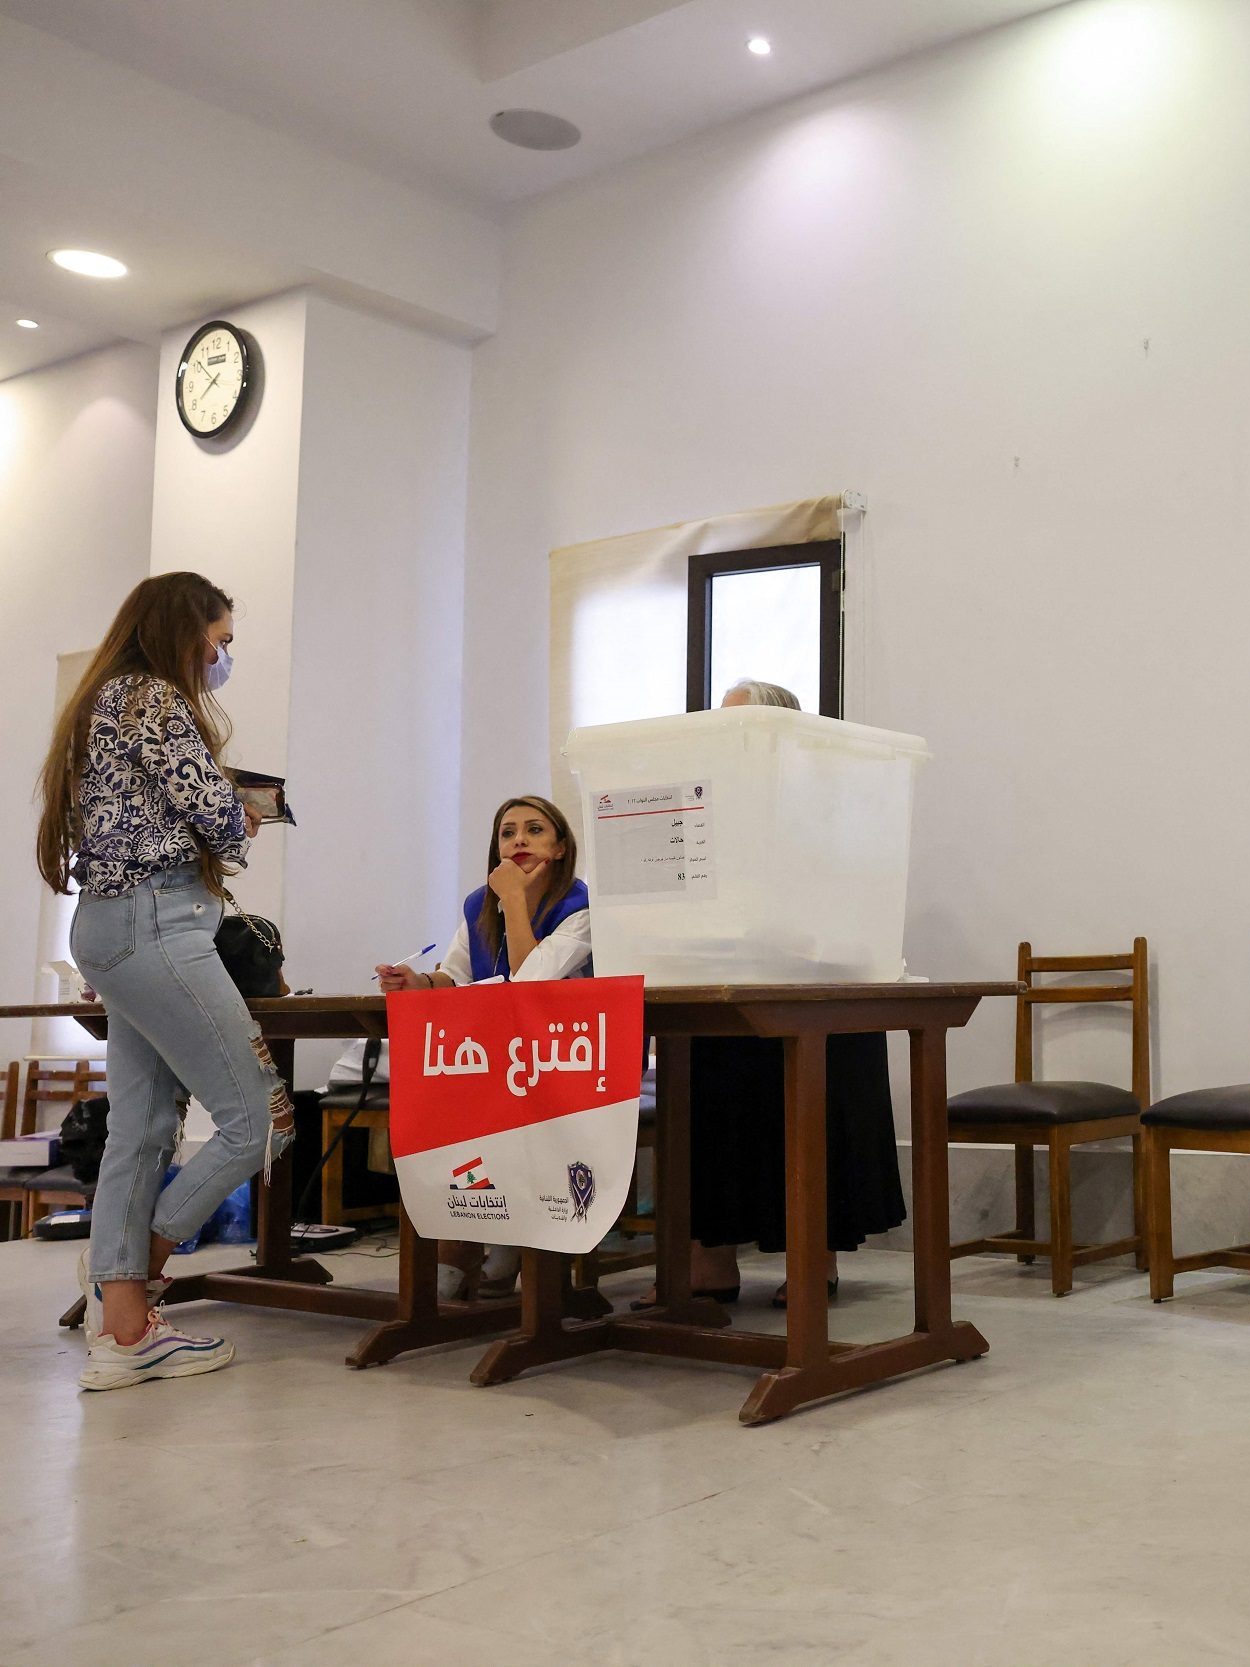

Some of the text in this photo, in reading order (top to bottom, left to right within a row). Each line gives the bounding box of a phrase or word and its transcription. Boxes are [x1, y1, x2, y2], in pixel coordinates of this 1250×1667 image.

[212, 338, 221, 349] 12
[201, 347, 209, 358] 11
[234, 352, 240, 363] 2
[193, 362, 201, 374] 10
[236, 369, 242, 381] 3
[188, 381, 194, 392] 9
[232, 389, 239, 399] 4
[192, 399, 197, 411] 8
[201, 411, 206, 422] 7
[223, 405, 229, 417] 5
[211, 412, 217, 425] 6
[671, 819, 683, 827] جبيل
[677, 873, 686, 881] 83
[423, 1012, 607, 1097] إقترع هنا
[447, 1195, 508, 1212] إنتخابات لبنان
[449, 1211, 510, 1221] LEBANON ELECTIONS
